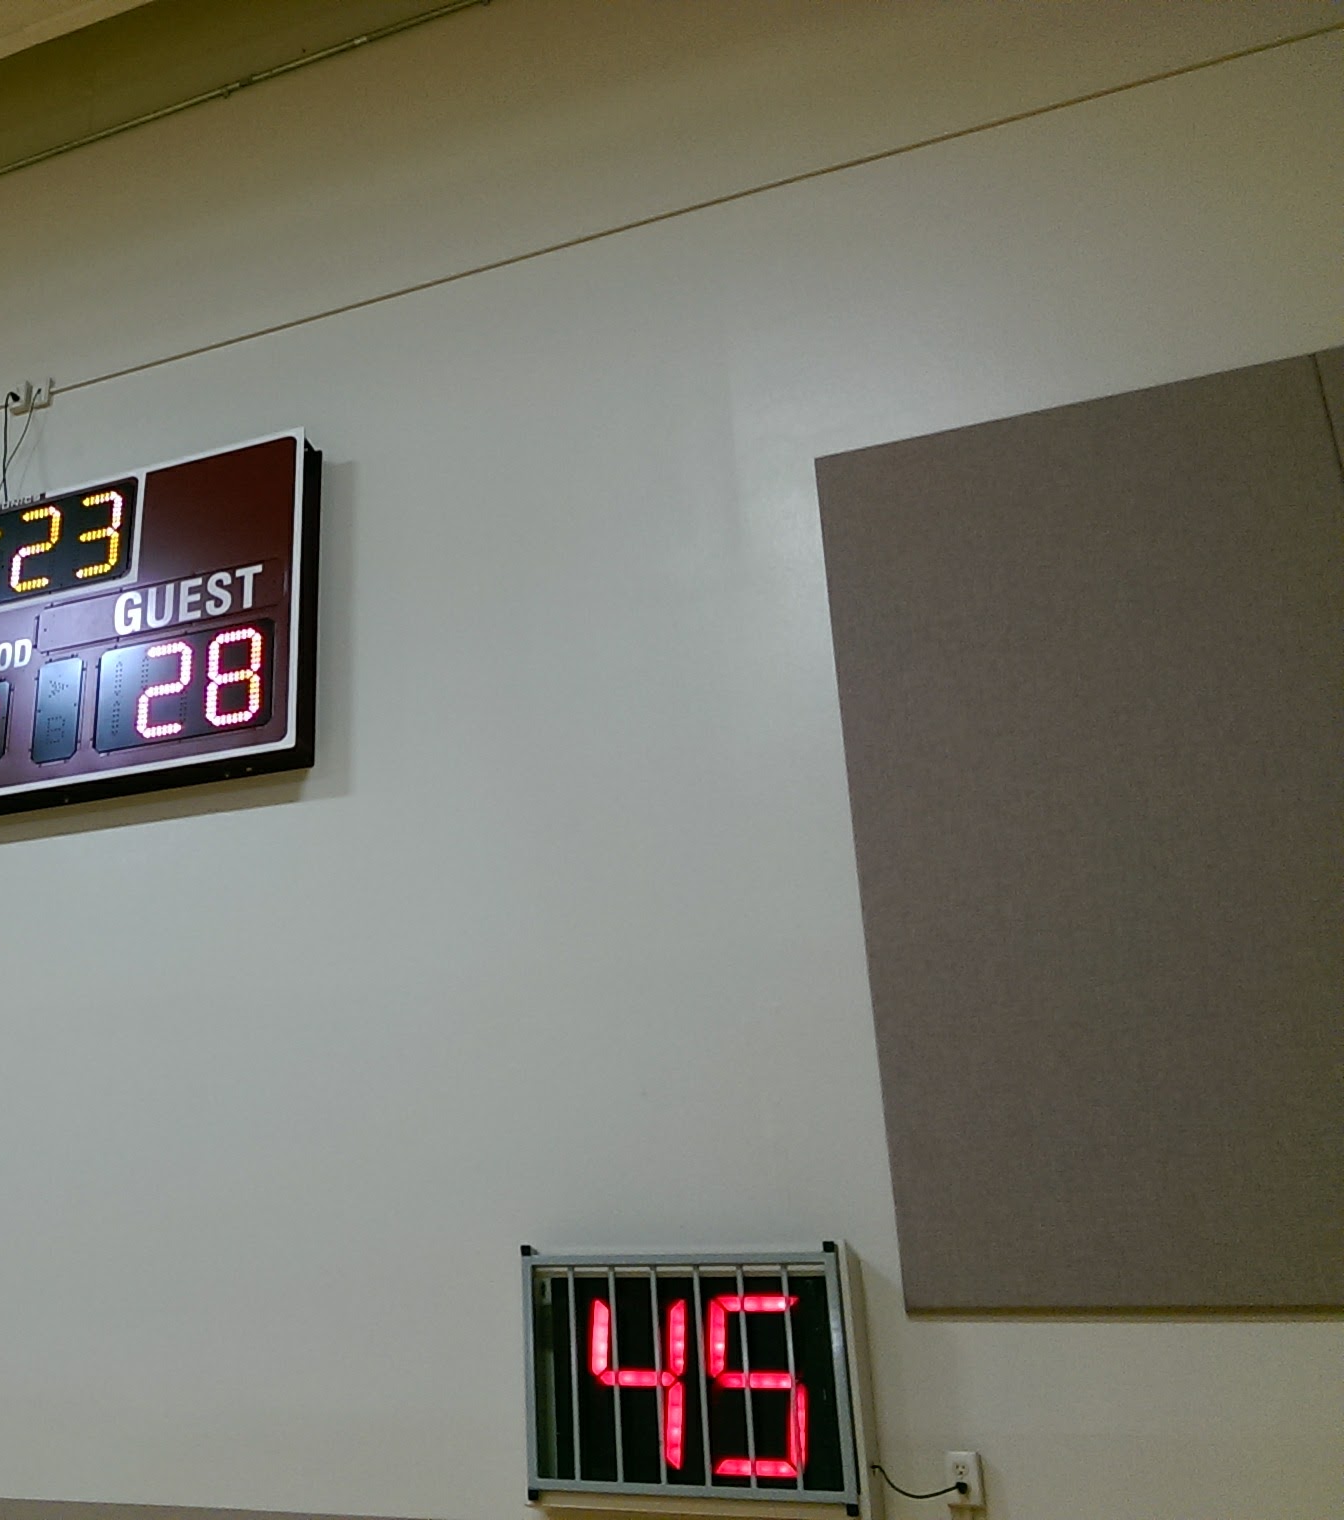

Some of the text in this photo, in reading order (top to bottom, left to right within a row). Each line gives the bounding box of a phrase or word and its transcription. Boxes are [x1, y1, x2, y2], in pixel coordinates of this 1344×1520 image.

[115, 565, 263, 636] GUEST
[136, 626, 262, 740] 28
[589, 1296, 808, 1477] 45
